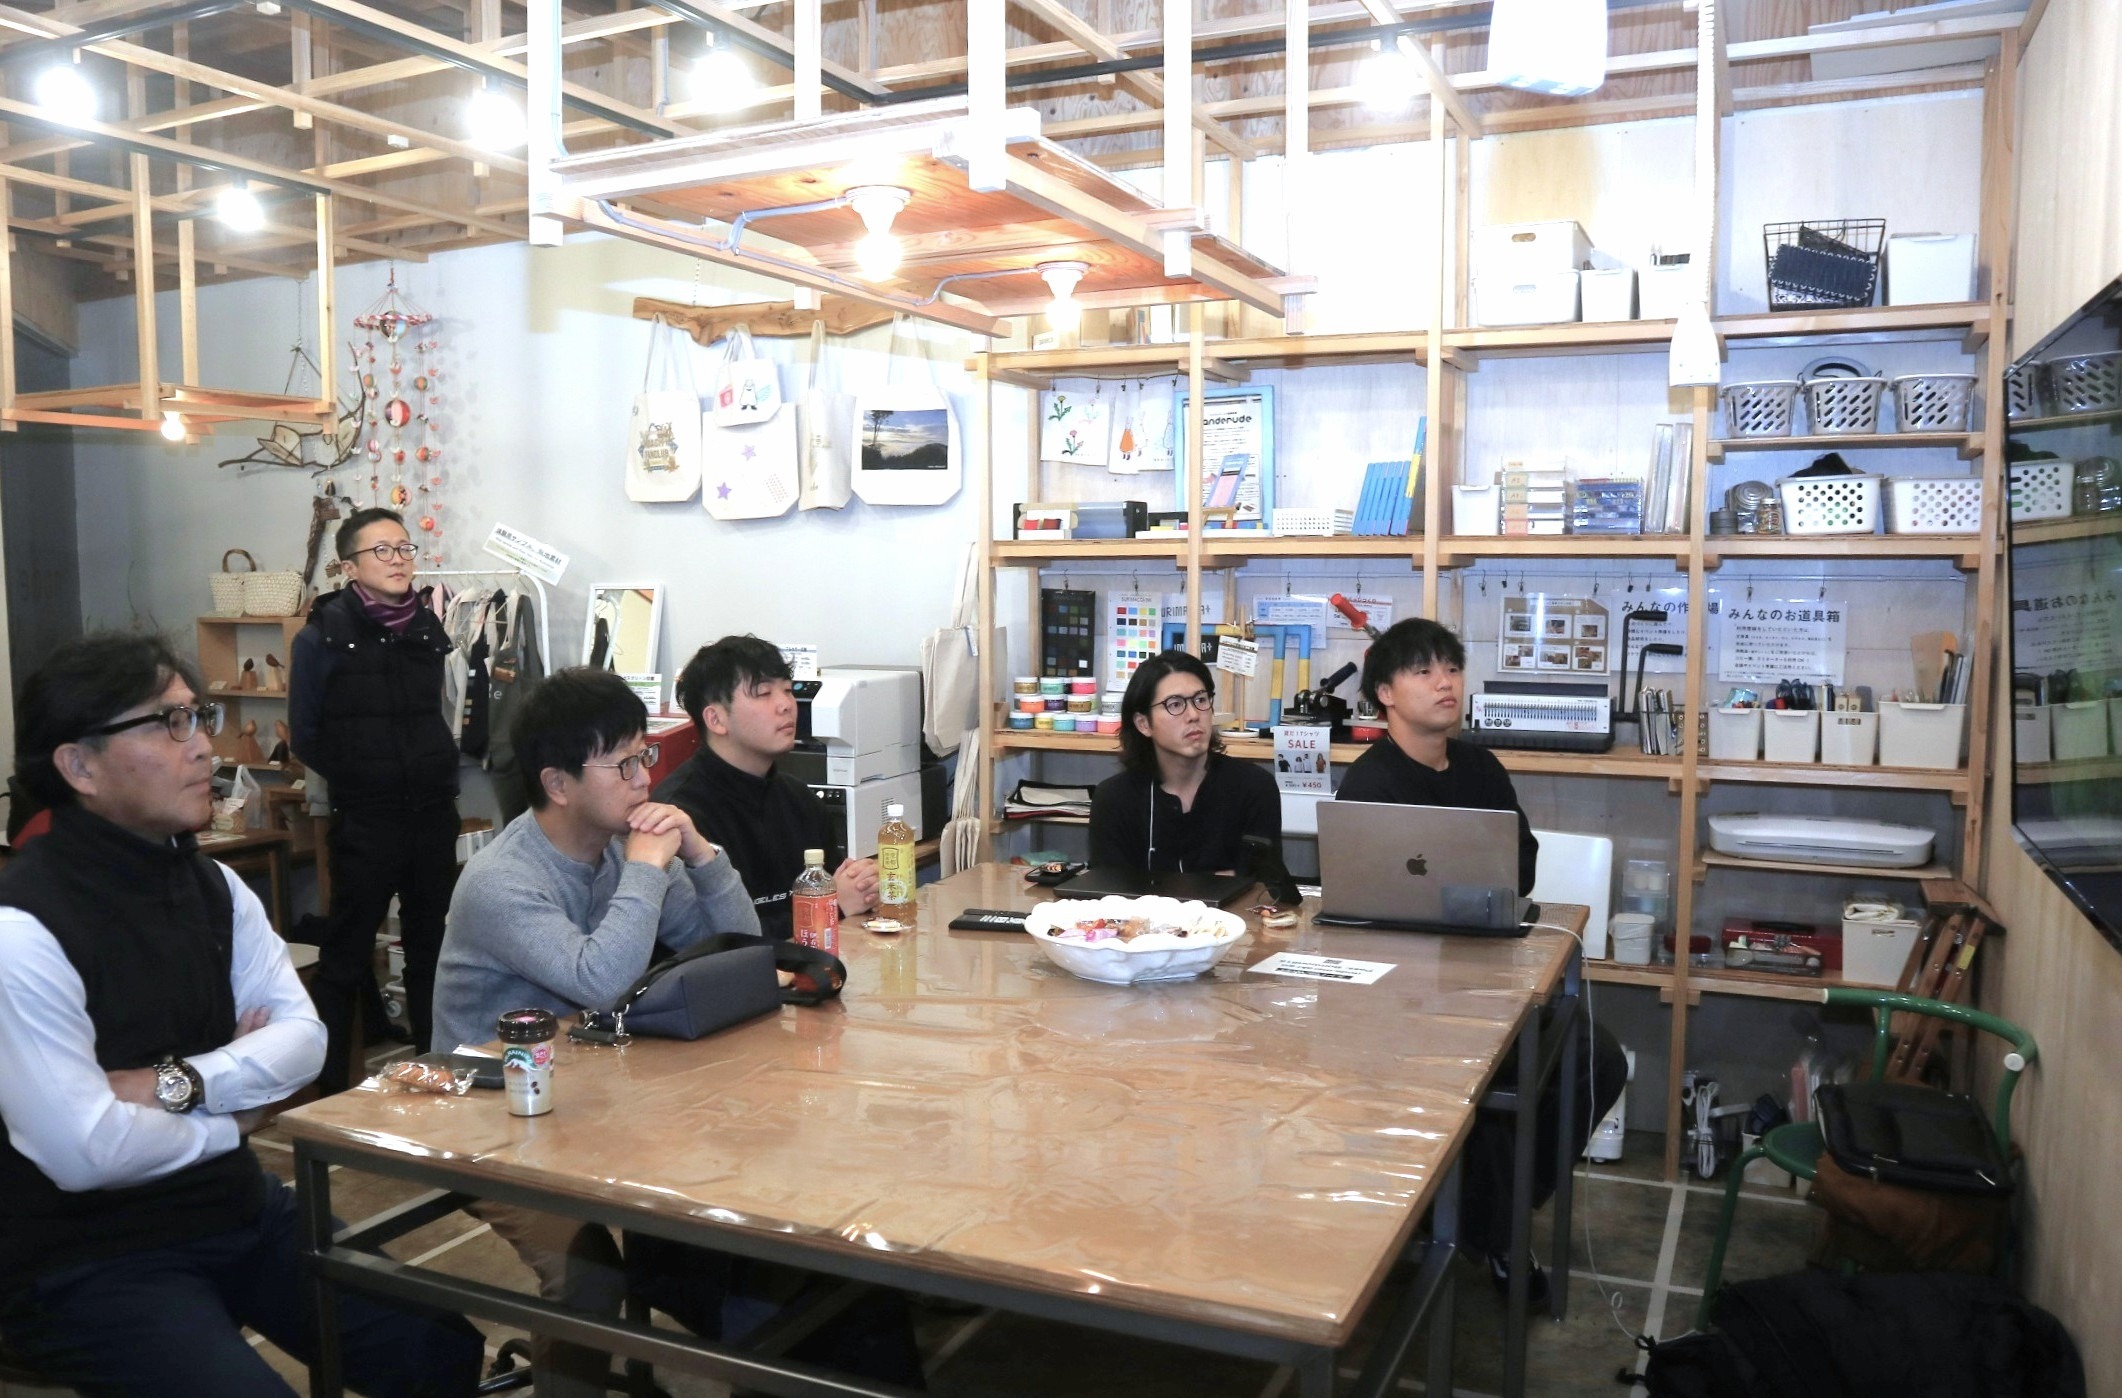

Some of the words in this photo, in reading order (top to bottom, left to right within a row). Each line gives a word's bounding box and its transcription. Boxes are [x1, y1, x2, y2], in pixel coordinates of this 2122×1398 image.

[1203, 414, 1253, 426] anderude
[1621, 600, 1719, 615] みんなの作場
[1728, 608, 1841, 623] みんなのお道具箱
[1287, 739, 1317, 750] SALE
[886, 871, 897, 900] 玄米茶
